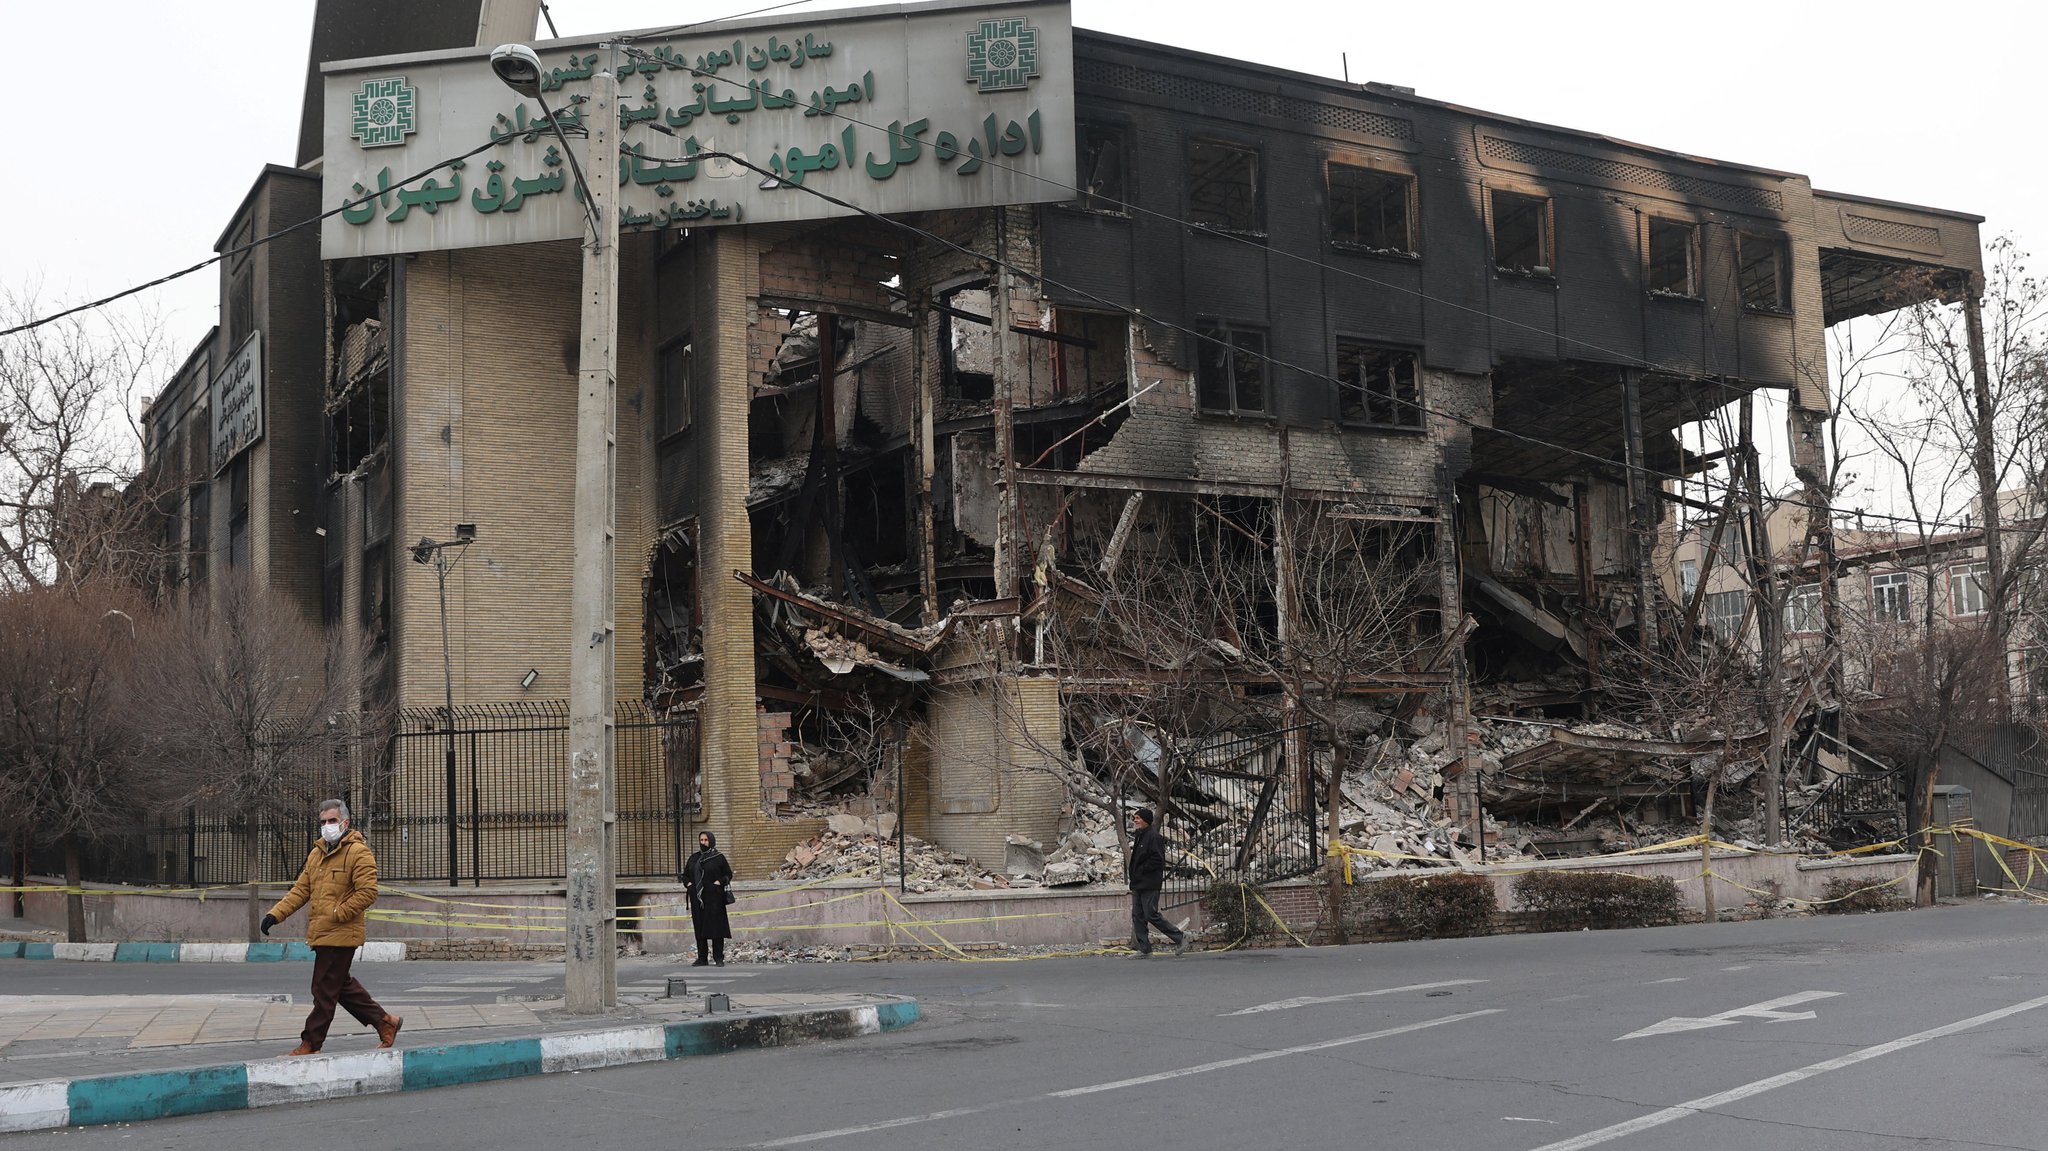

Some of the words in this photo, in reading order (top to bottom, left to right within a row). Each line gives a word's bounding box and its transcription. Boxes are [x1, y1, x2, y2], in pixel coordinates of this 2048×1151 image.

[541, 53, 599, 91] کشور
[603, 45, 687, 83] مالیی
[690, 39, 742, 77] امور
[746, 32, 833, 71] سازمان
[619, 84, 660, 129] شه
[665, 78, 796, 127] مالیاتی
[804, 69, 875, 117] امور
[758, 122, 857, 190] امور
[865, 117, 929, 181] کل
[934, 107, 1043, 176] اداره
[341, 159, 466, 225] تهران
[471, 144, 567, 213] شرق
[619, 205, 653, 231] سبلا
